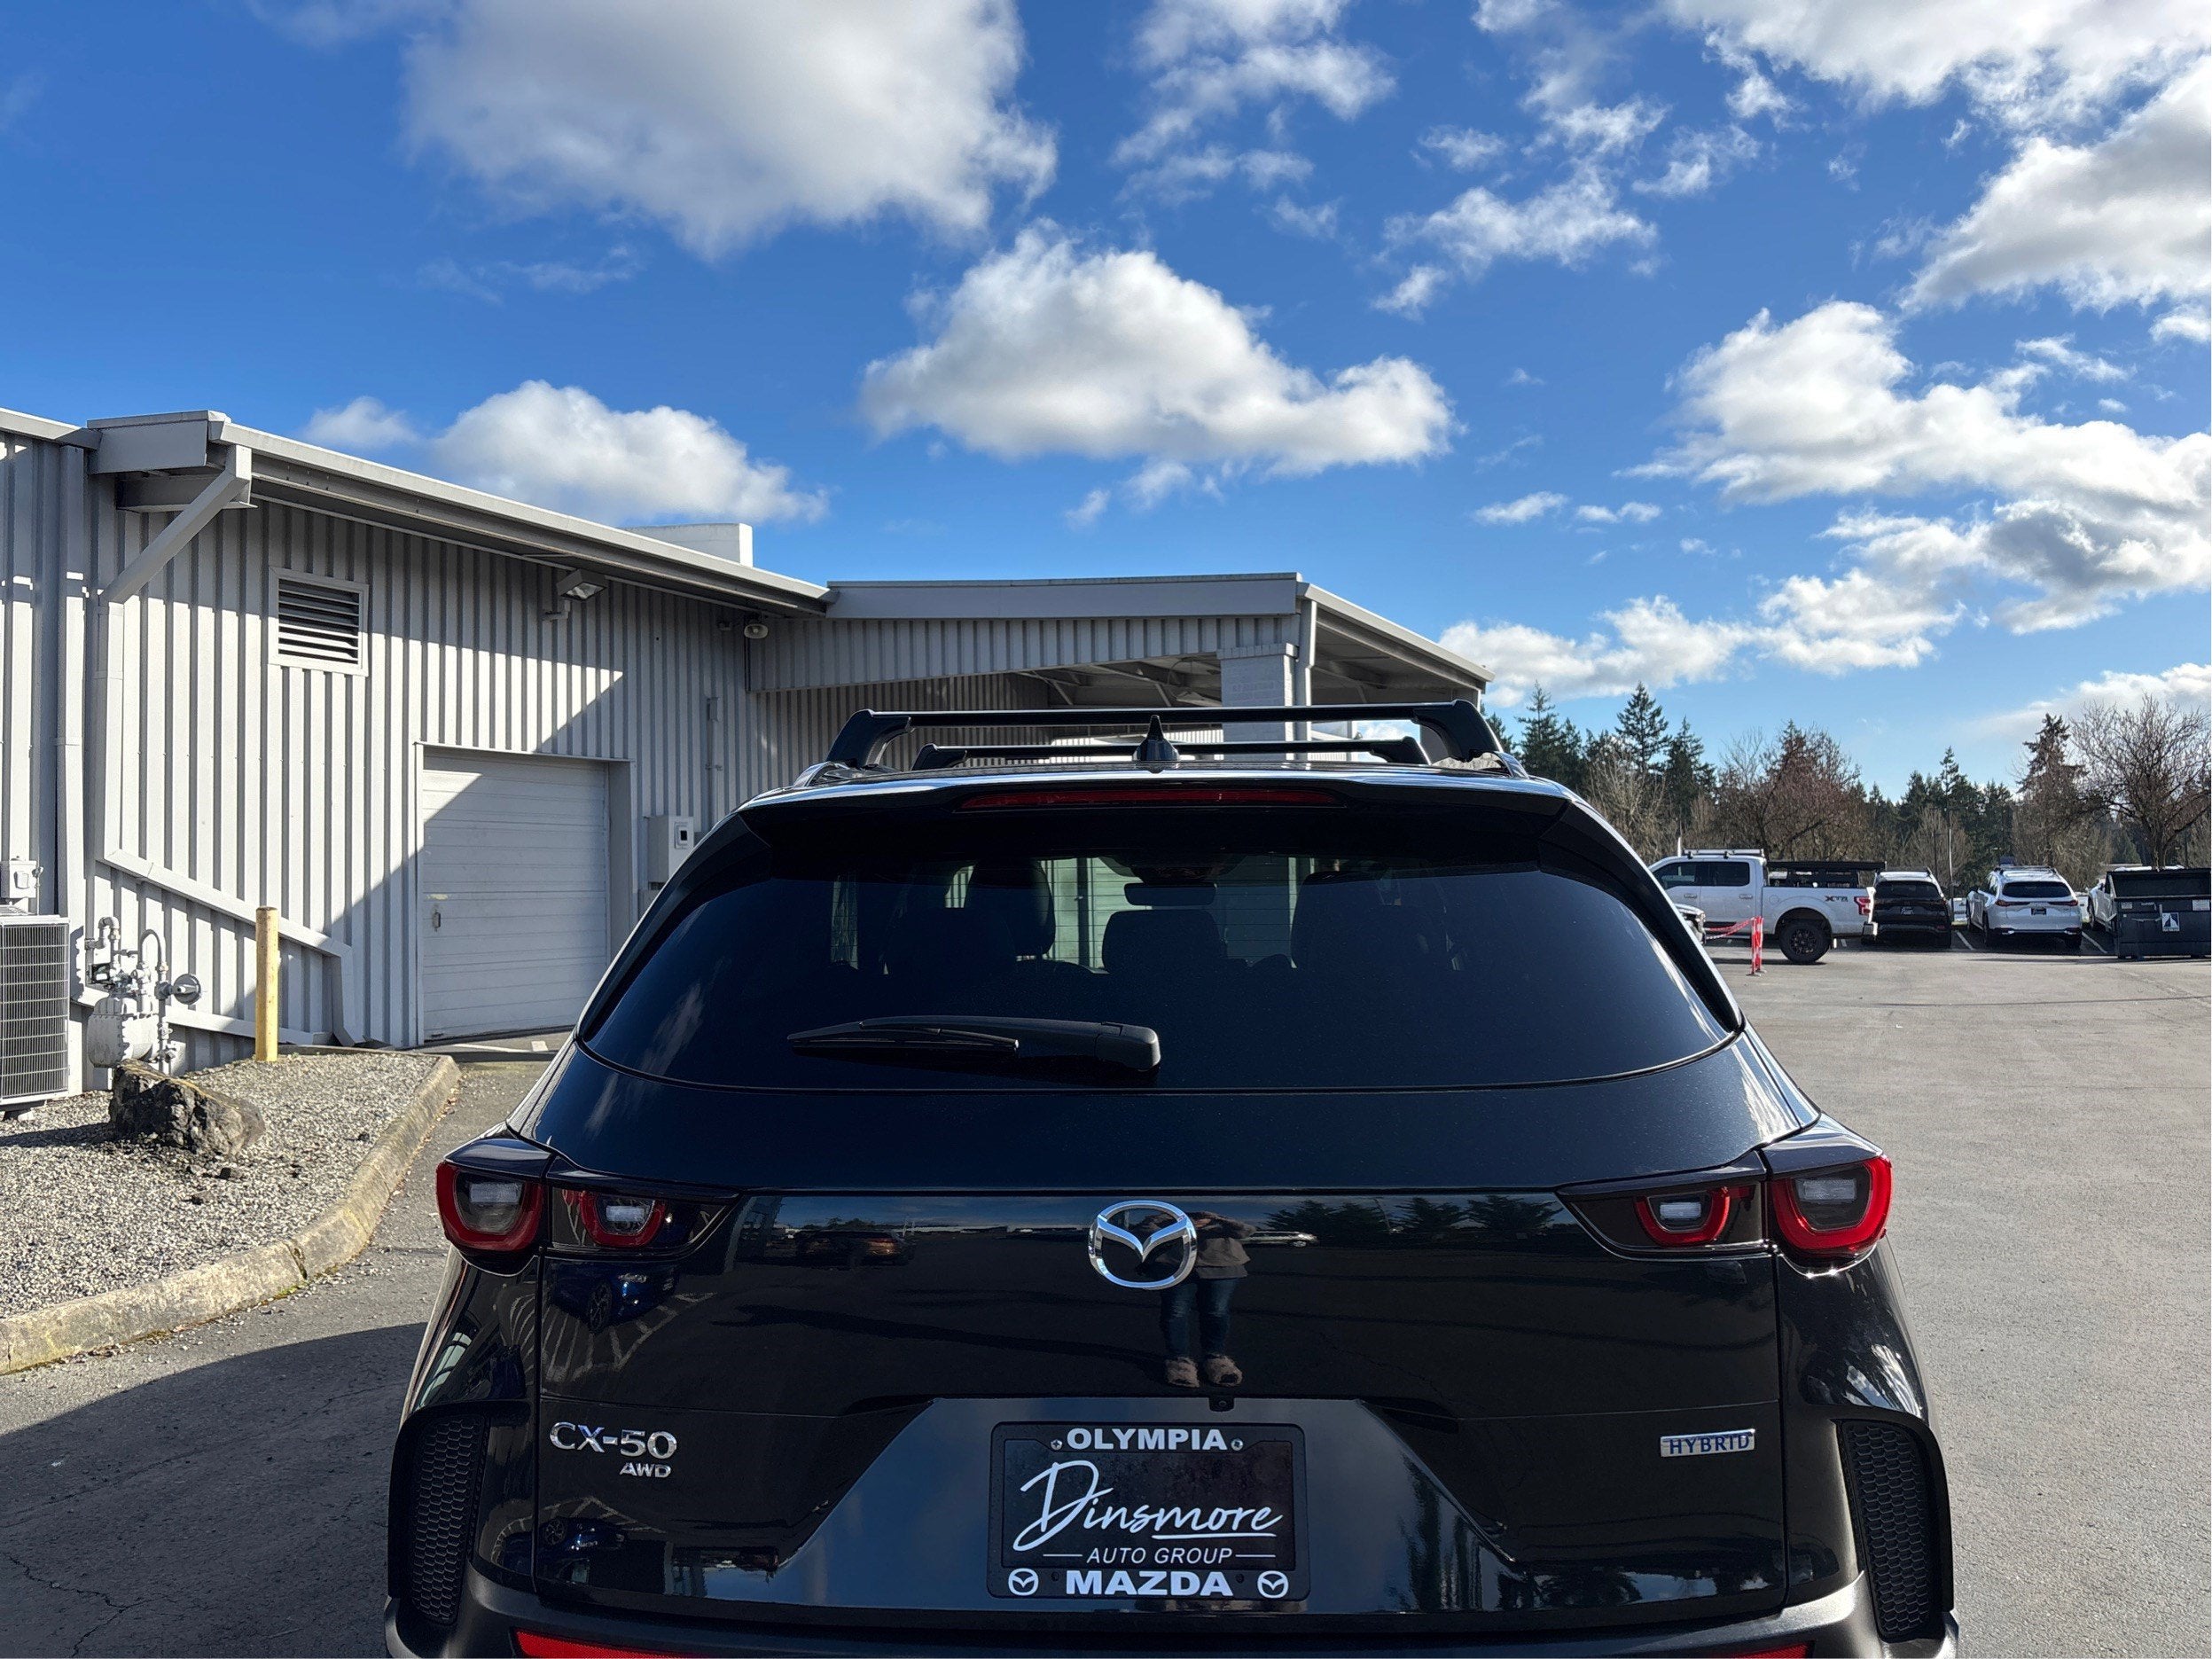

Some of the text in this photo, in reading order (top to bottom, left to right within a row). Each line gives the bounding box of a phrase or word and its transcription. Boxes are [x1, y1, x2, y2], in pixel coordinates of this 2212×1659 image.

[550, 1421, 677, 1459] CX-50
[1067, 1428, 1228, 1451] OLYMPIA
[1669, 1435, 1750, 1455] HYBRID
[619, 1462, 672, 1478] AWD
[1012, 1459, 1284, 1551] Dinsmore
[1086, 1548, 1233, 1564] AUTO GROUP
[1066, 1570, 1234, 1597] MAZDA
